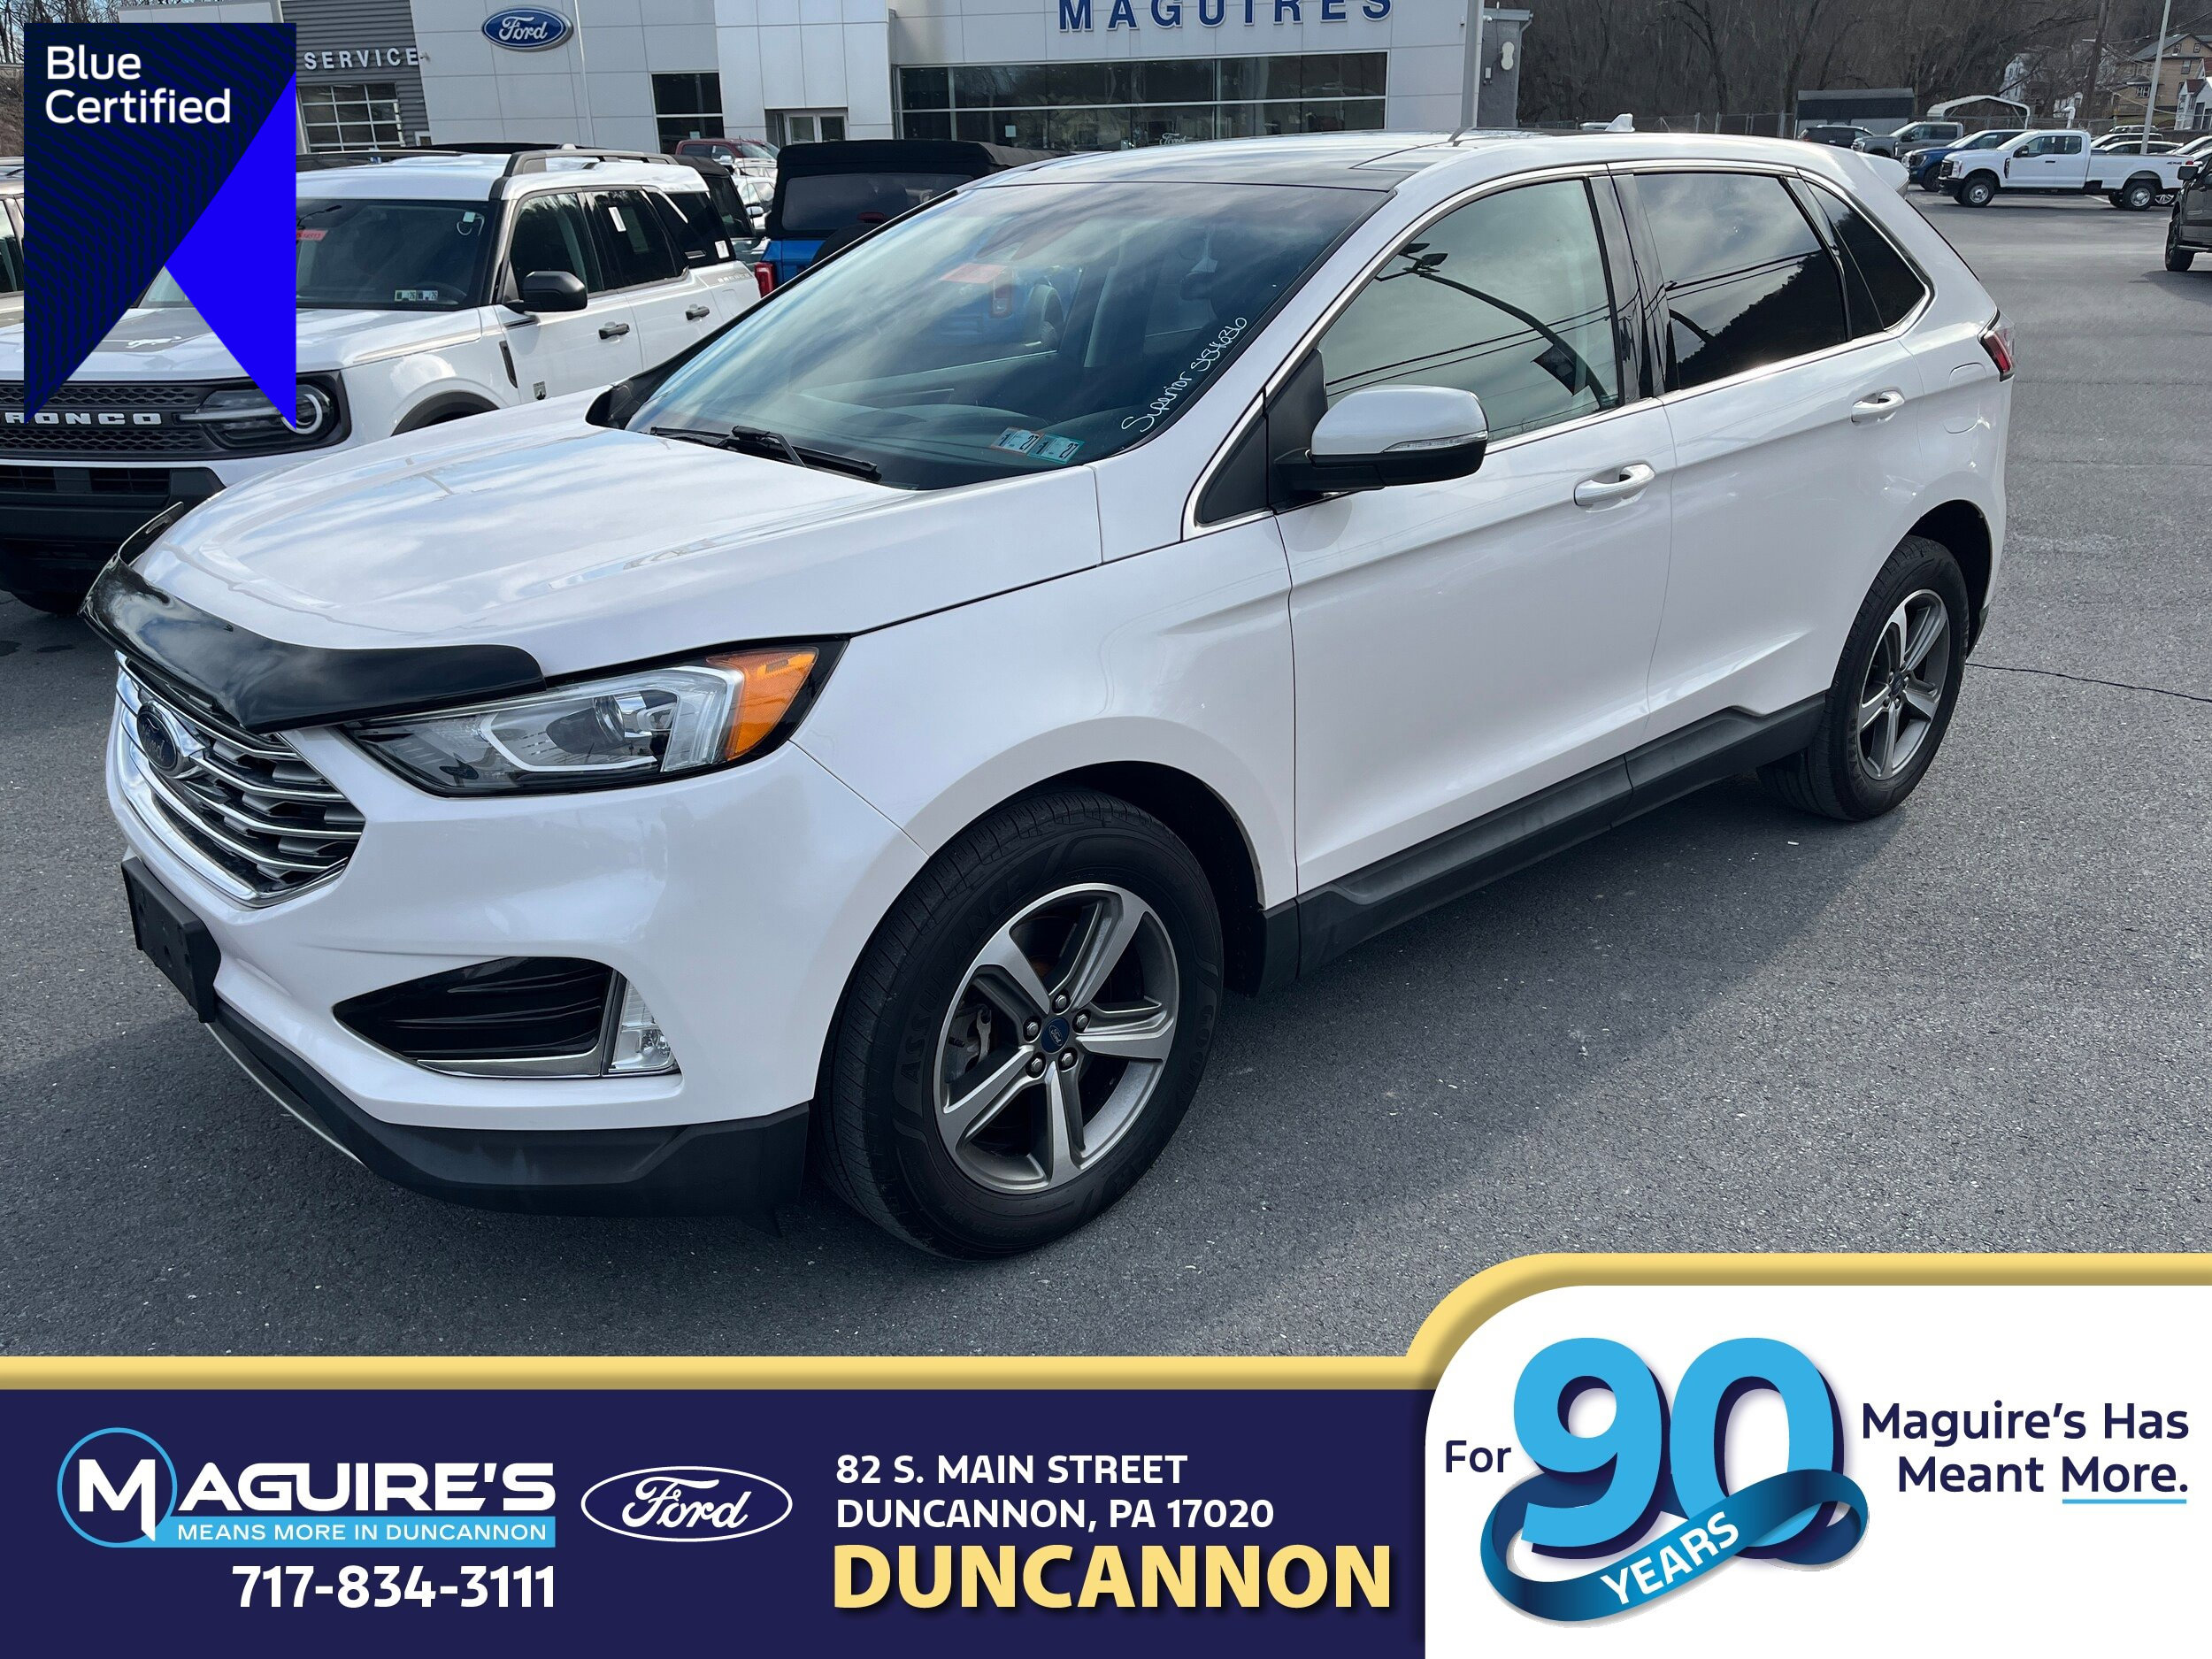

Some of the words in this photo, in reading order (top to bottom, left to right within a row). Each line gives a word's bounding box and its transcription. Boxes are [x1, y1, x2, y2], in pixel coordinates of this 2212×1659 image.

[498, 16, 548, 41] Ford
[303, 48, 419, 70] SERVICE
[1121, 371, 1193, 433] Superior
